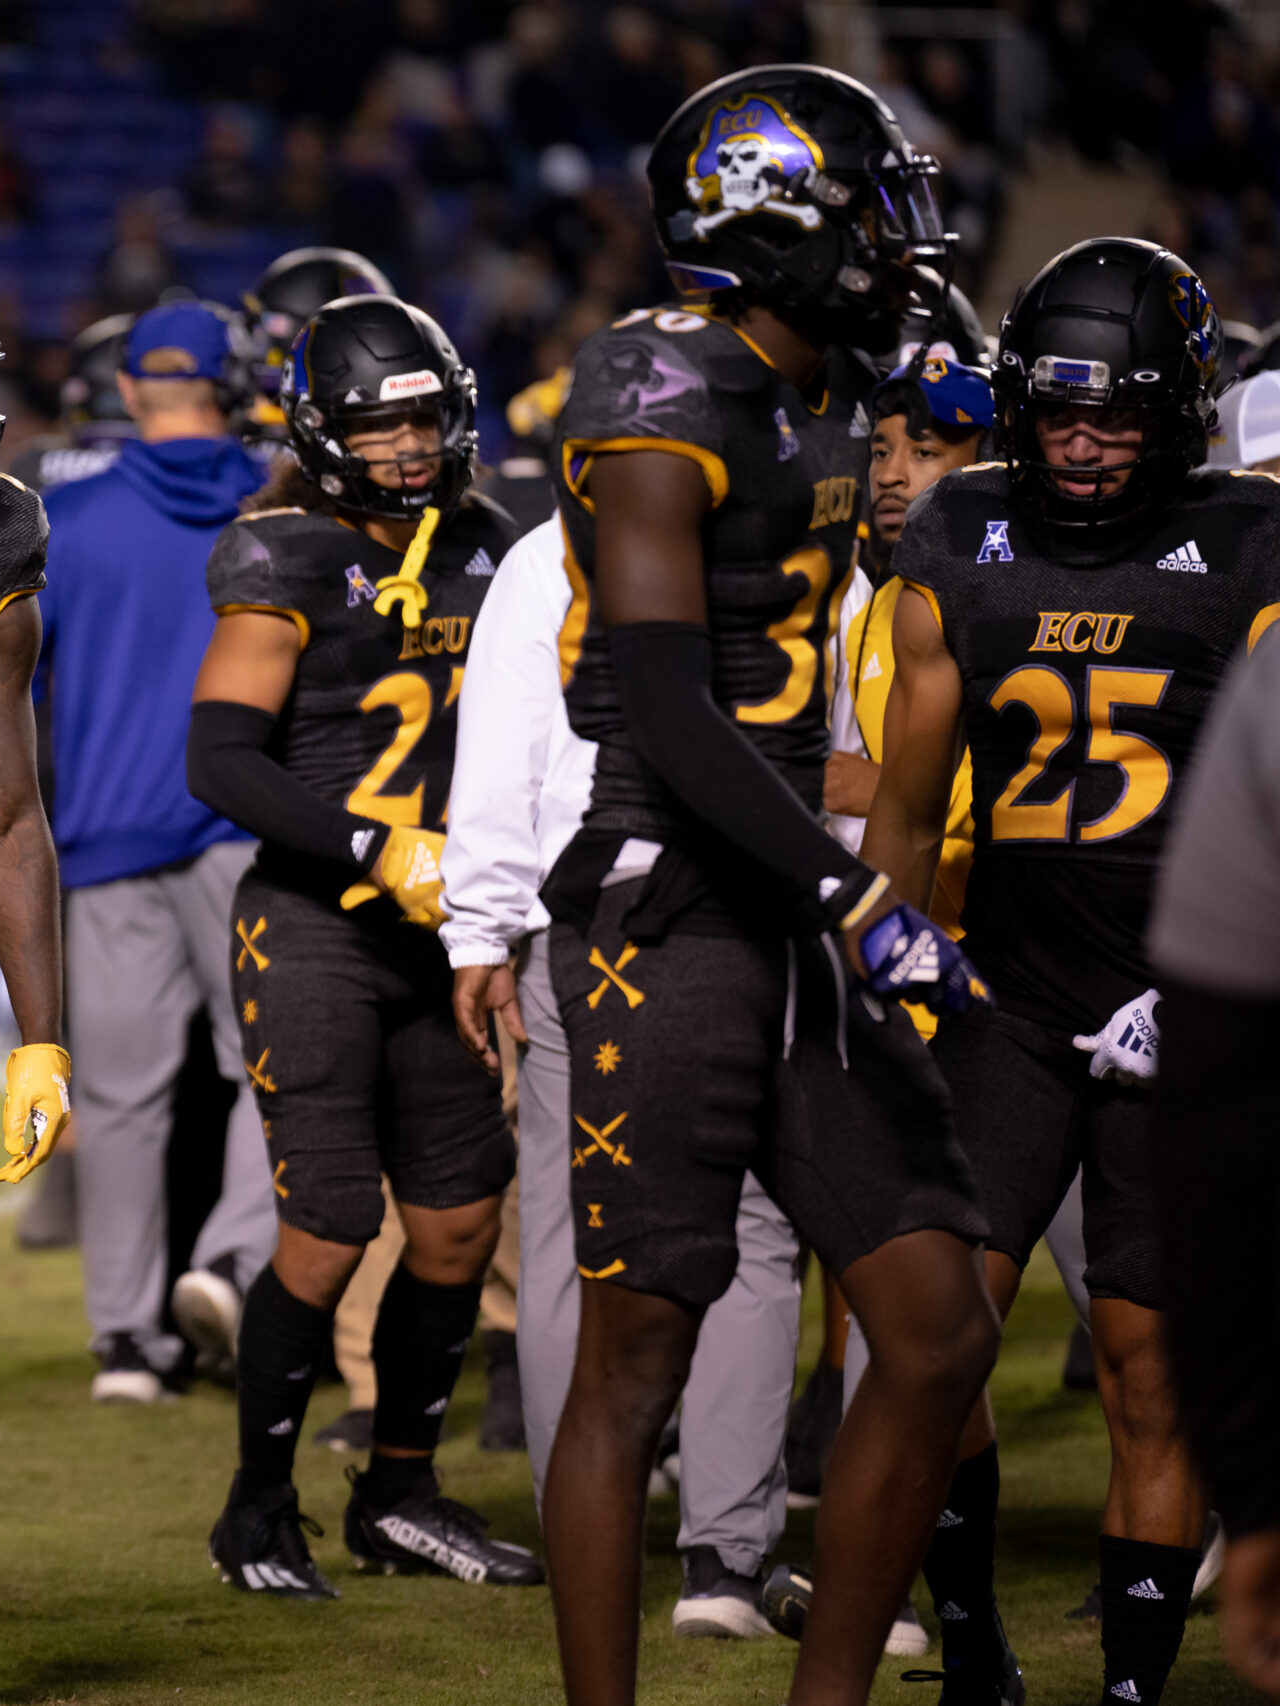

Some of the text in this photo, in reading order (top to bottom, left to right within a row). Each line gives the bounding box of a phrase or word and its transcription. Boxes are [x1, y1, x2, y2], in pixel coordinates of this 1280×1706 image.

[718, 110, 762, 134] ECU
[389, 375, 432, 391] Riddell
[808, 475, 859, 531] ECU
[1156, 557, 1208, 574] adidas
[397, 616, 471, 661] ECU
[1028, 611, 1135, 655] ECU
[985, 663, 1175, 845] 25
[887, 928, 934, 985] adidas
[1132, 1008, 1161, 1053] didas
[375, 1514, 488, 1585] ADIZERO
[1127, 1586, 1165, 1600] adidas
[1111, 1685, 1141, 1703] adidas
